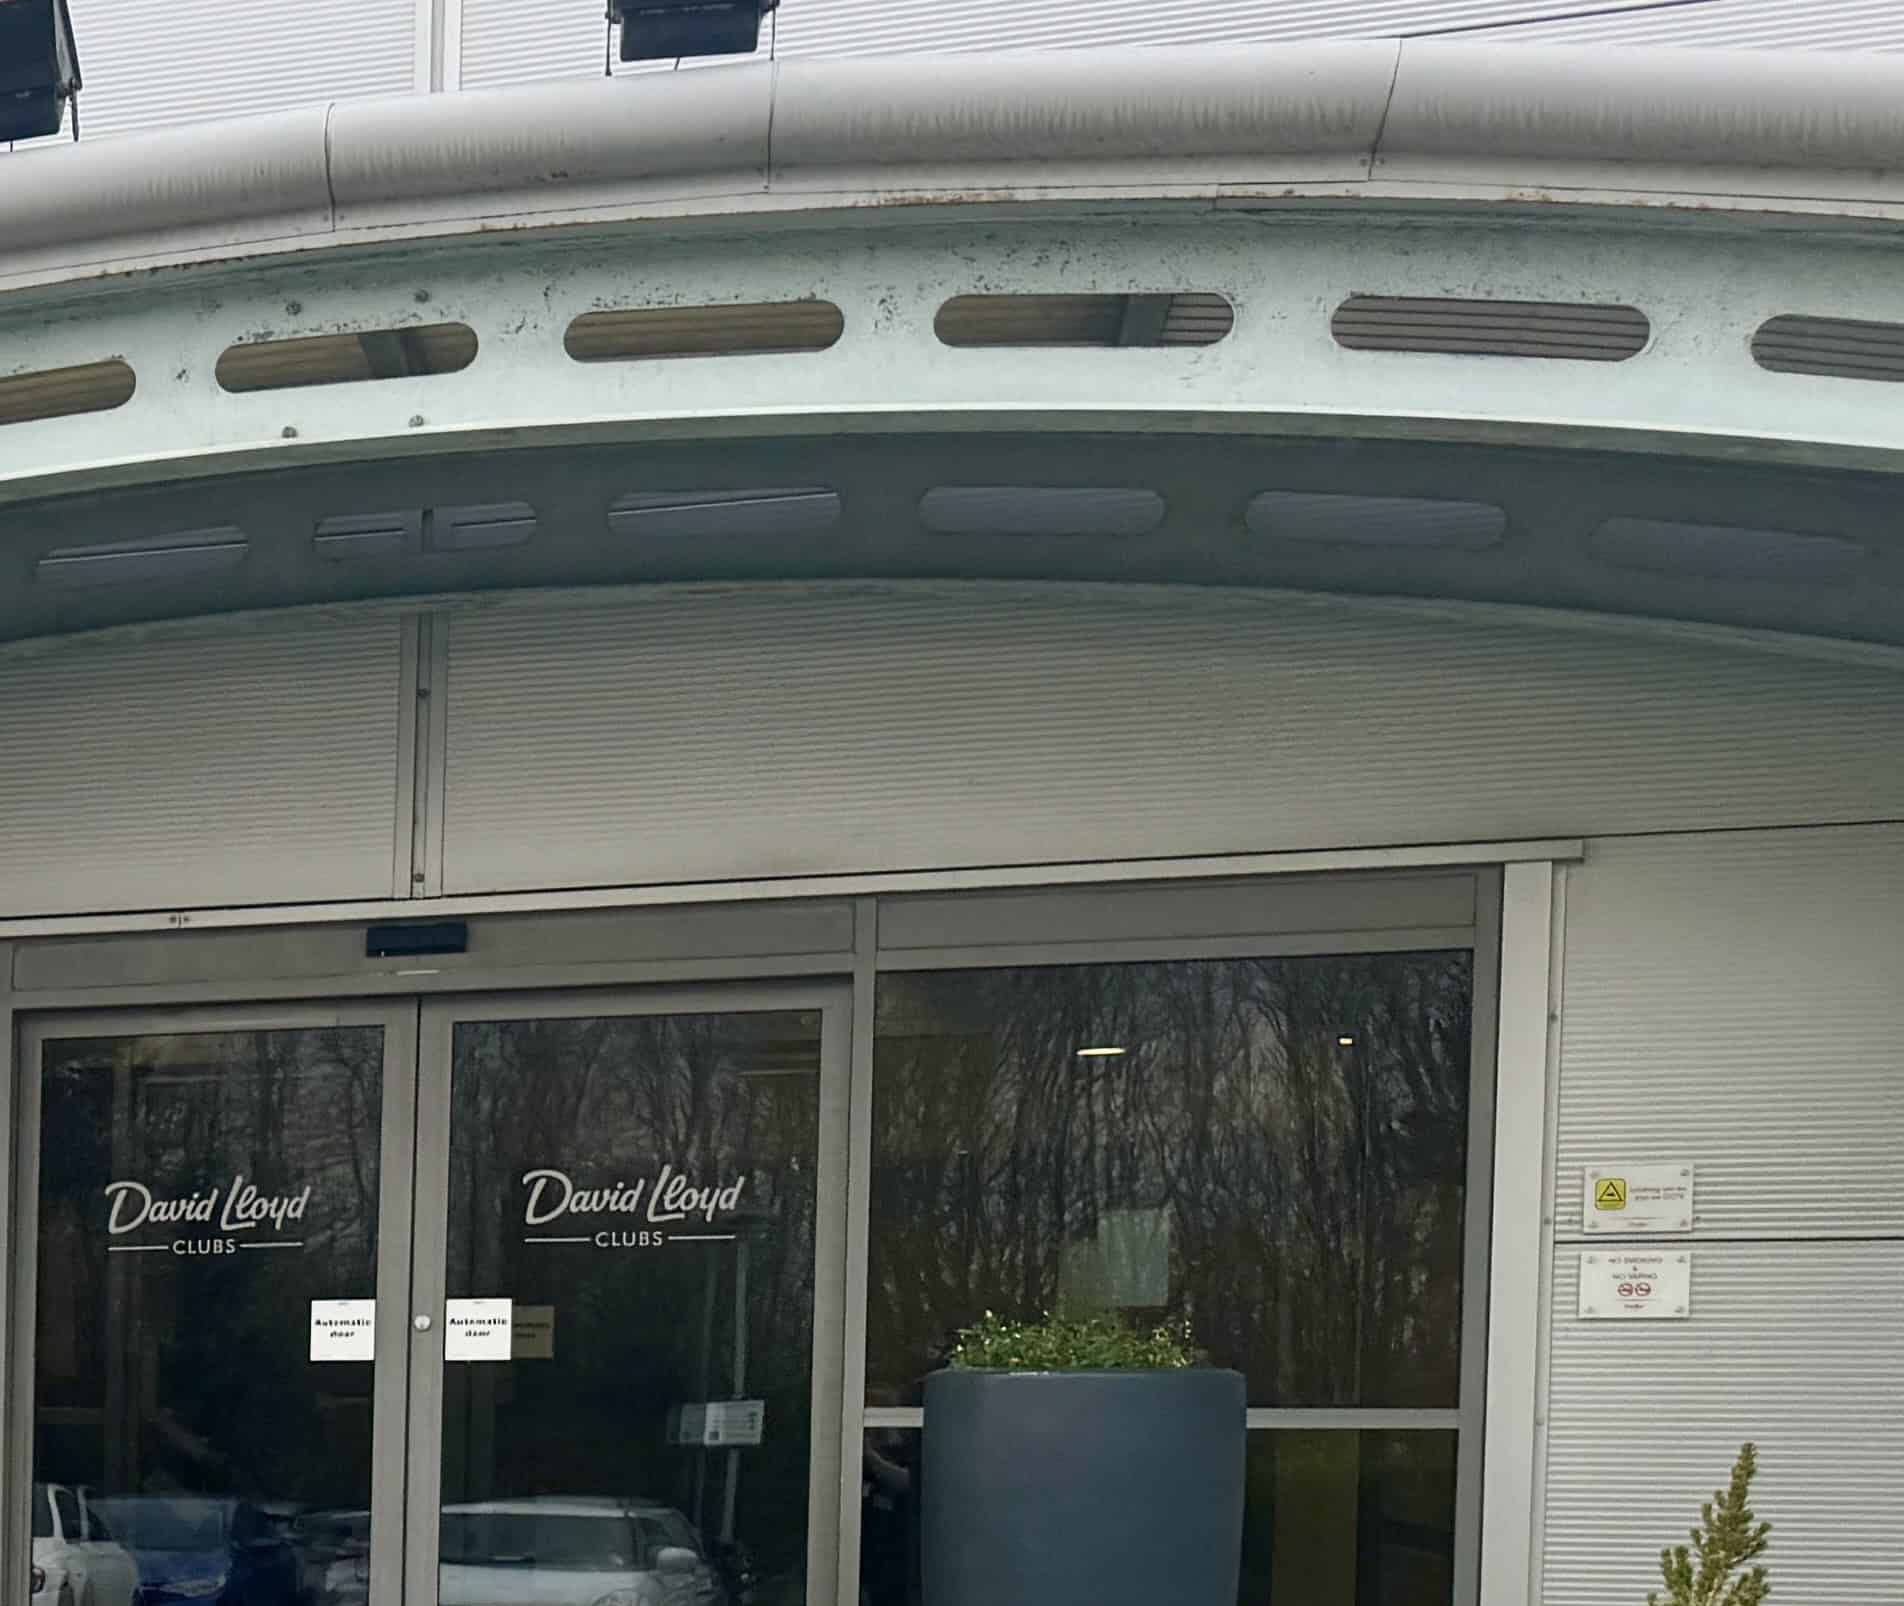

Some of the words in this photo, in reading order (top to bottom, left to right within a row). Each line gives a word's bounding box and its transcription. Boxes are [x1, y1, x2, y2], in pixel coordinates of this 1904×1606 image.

[104, 1181, 220, 1235] David
[220, 1175, 312, 1231] Lloyd
[522, 1169, 645, 1225] David
[646, 1164, 746, 1223] Lloyd
[172, 1238, 237, 1255] CLUBS
[594, 1230, 664, 1248] CLUBS
